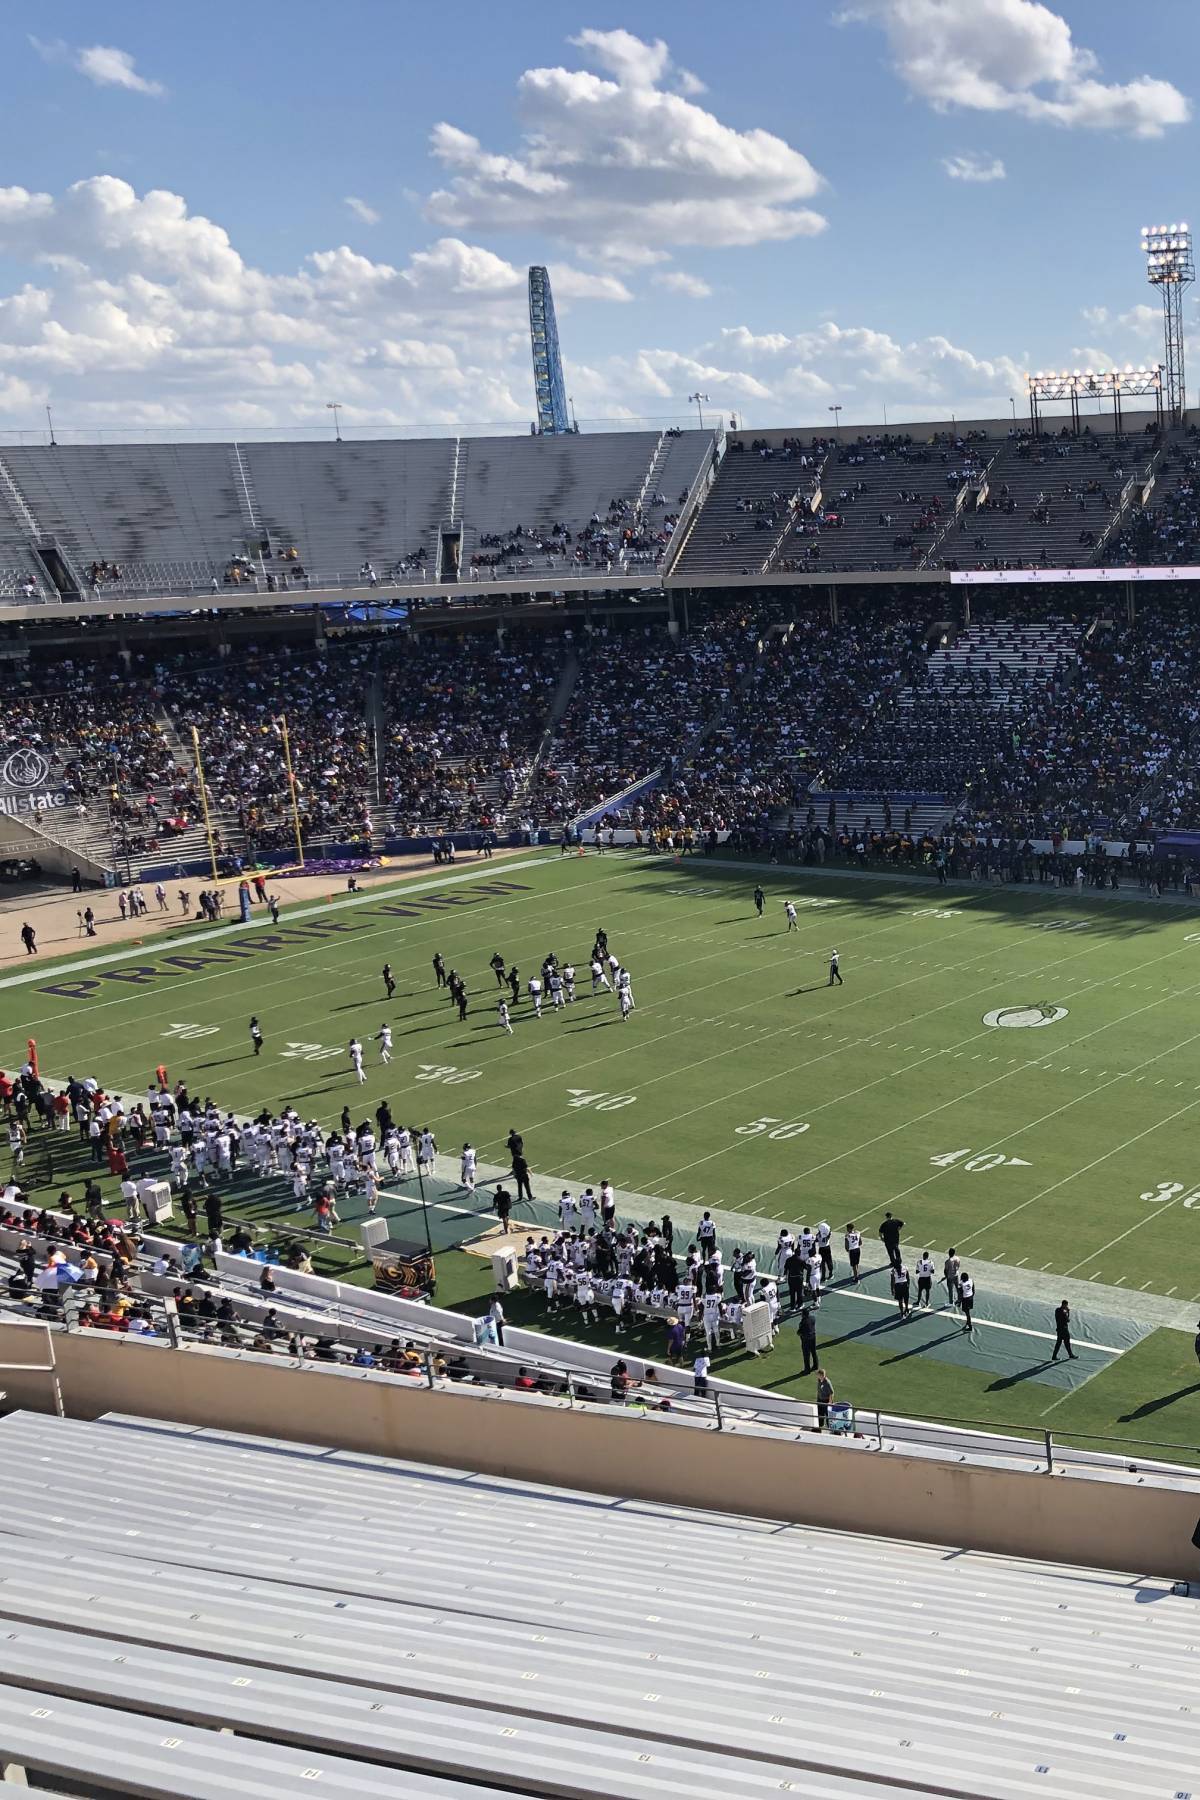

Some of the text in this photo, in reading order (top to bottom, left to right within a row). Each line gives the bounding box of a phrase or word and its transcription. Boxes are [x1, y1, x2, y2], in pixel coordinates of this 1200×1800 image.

[36, 881, 536, 998] PRAIRIE VIEW
[160, 1025, 220, 1040] 10
[279, 1043, 345, 1060] 20
[415, 1065, 483, 1084] 30
[567, 1093, 637, 1110] 40
[734, 1117, 810, 1139] 50
[930, 1148, 1006, 1172] 40
[703, 1226, 711, 1234] 47
[802, 1239, 811, 1248] 96
[923, 1264, 928, 1272] 6
[578, 1278, 587, 1286] 56
[680, 1290, 690, 1300] 99
[706, 1299, 716, 1309] 97
